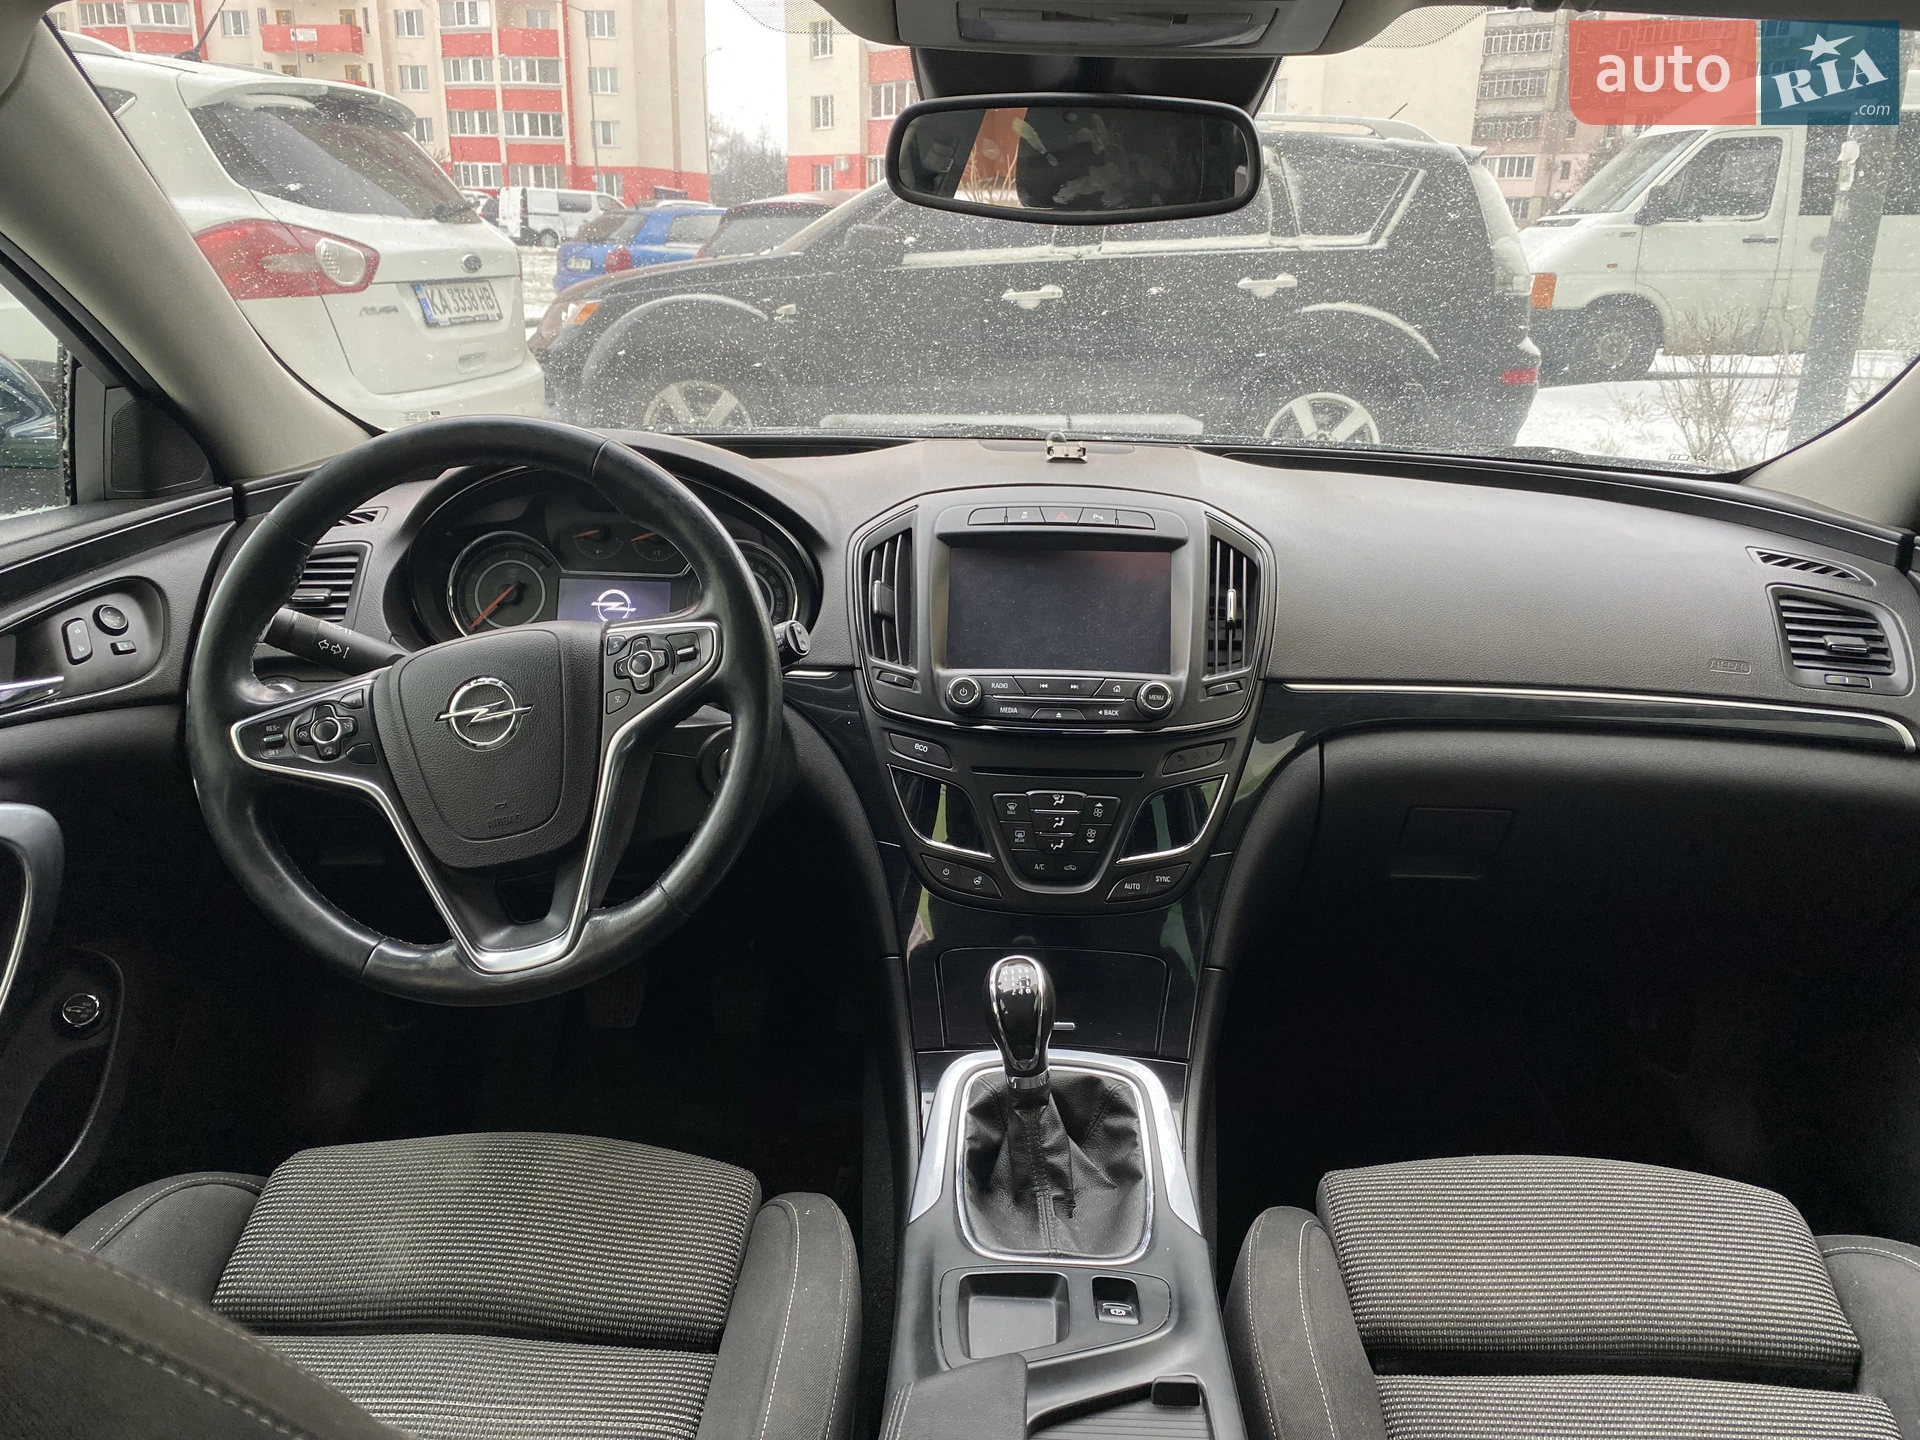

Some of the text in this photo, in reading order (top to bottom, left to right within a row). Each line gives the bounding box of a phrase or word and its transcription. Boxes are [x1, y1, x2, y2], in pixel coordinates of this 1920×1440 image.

[425, 289, 452, 315] KA
[447, 286, 479, 313] 3358
[1103, 709, 1119, 717] BACK
[914, 742, 928, 753] eco
[1155, 875, 1171, 883] SYNC
[1124, 882, 1140, 890] AUTO
